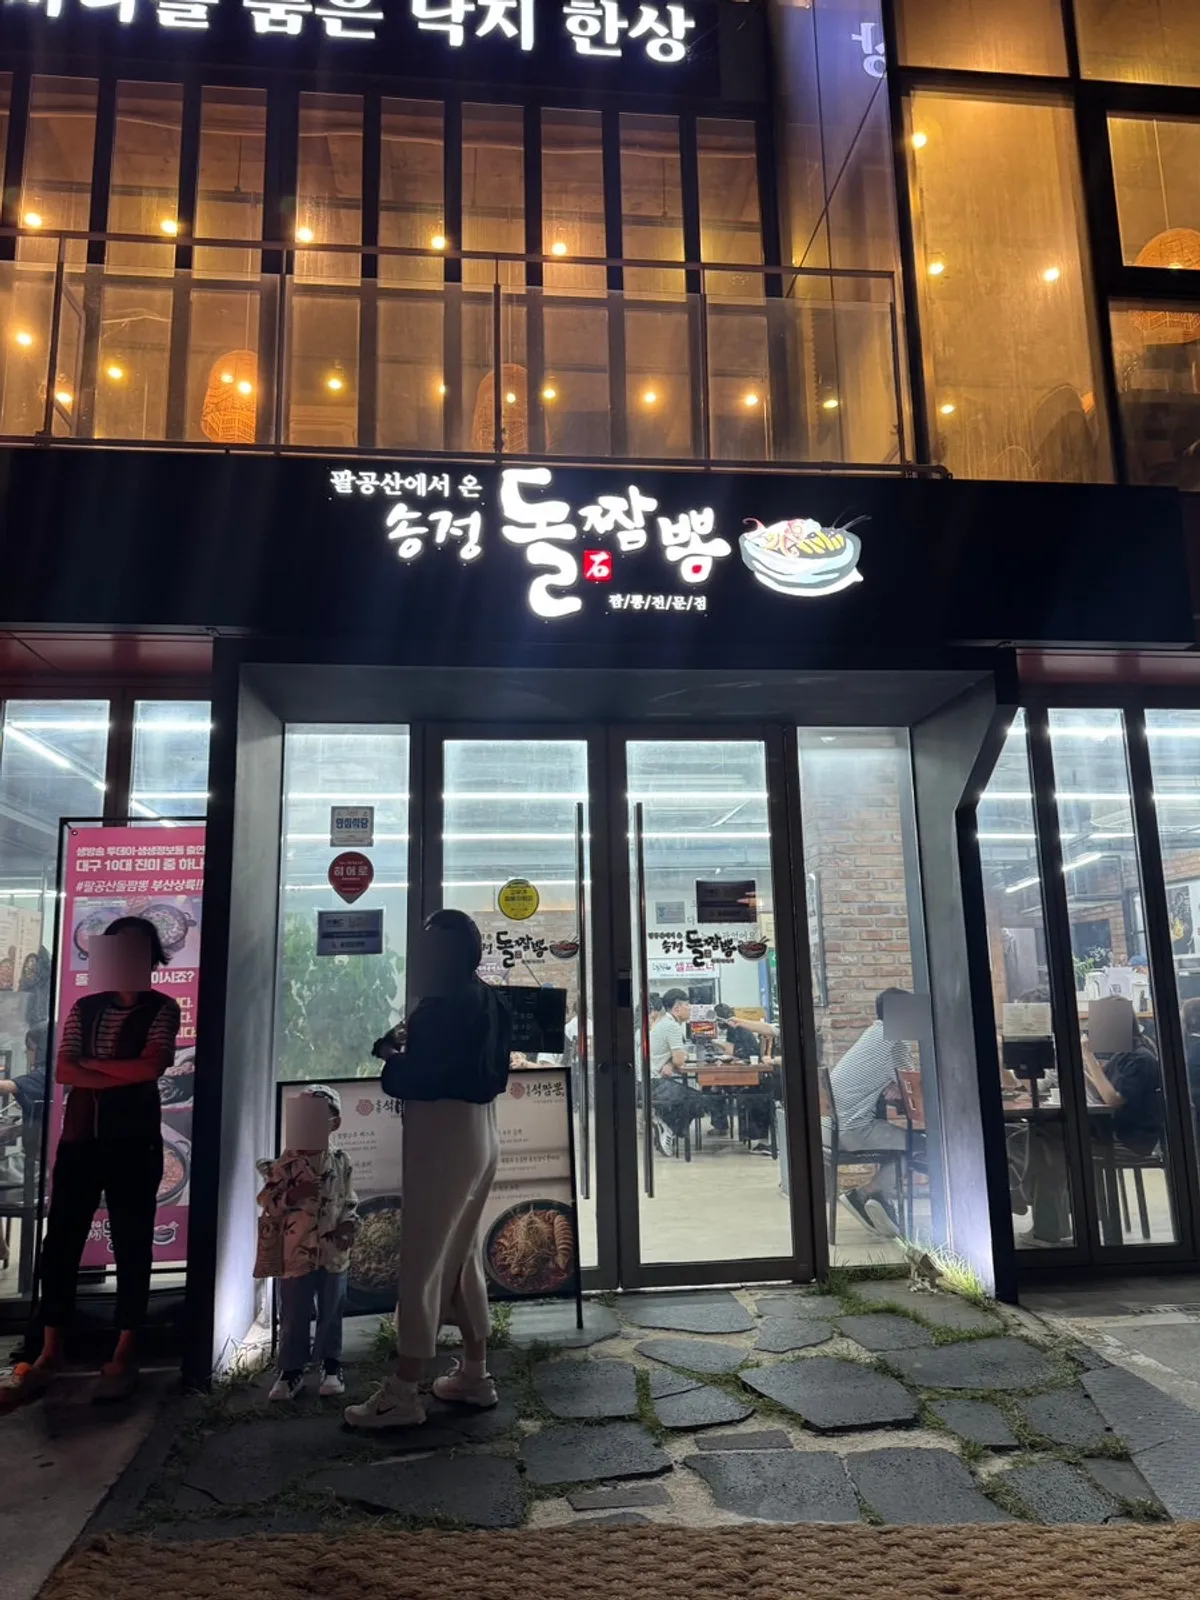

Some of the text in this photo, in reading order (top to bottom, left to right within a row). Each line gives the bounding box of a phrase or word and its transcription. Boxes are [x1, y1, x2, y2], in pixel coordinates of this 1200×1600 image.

[564, 0, 695, 63] 한상
[330, 470, 483, 498] 팔공산에서 온
[386, 502, 482, 560] 송정
[76, 859, 101, 872] 대구
[104, 859, 132, 871] 10대
